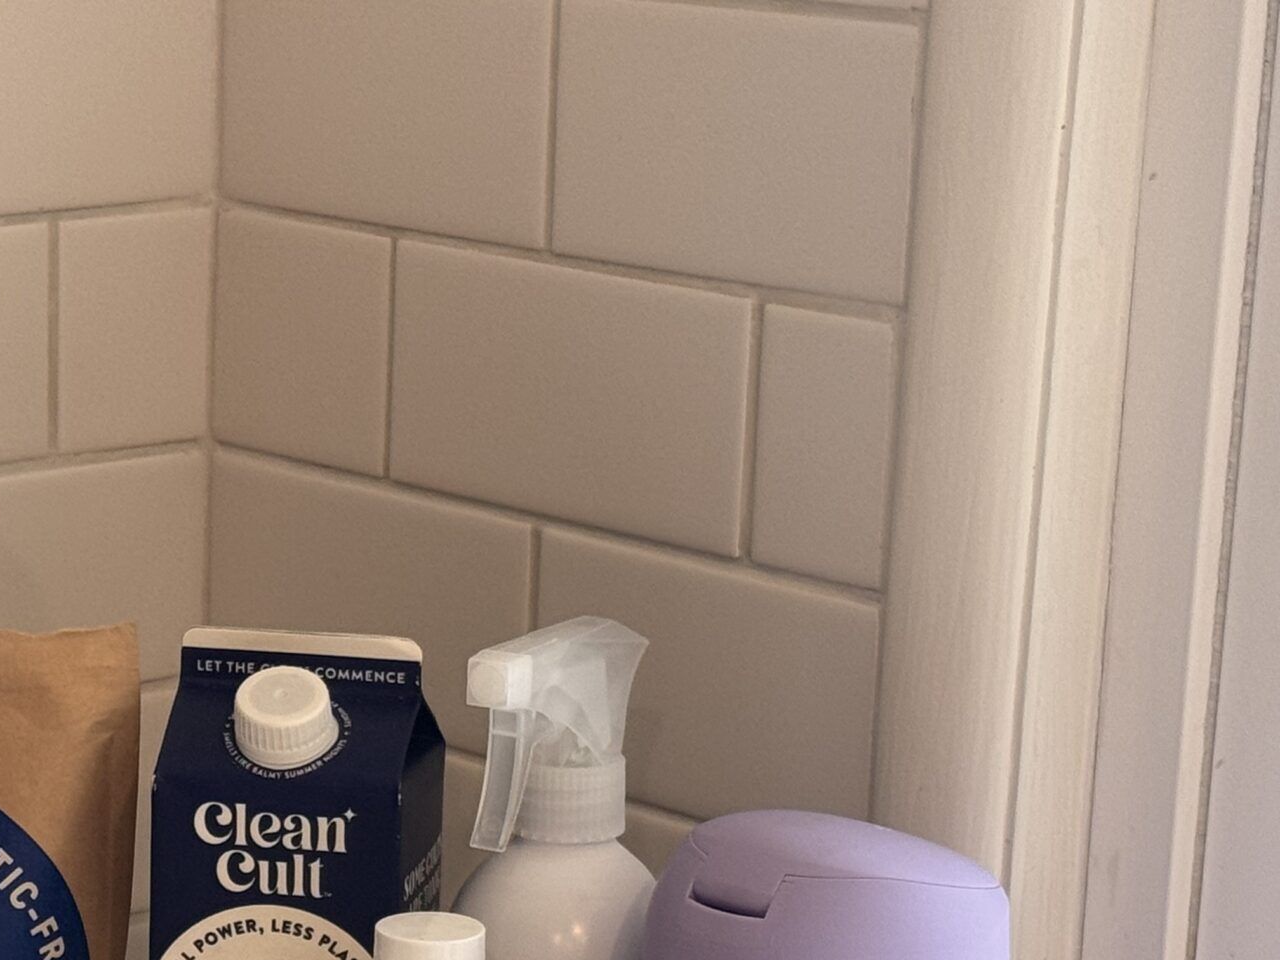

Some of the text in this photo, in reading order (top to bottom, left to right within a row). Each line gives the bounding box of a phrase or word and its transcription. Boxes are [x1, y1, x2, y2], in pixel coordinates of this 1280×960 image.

[197, 660, 222, 672] LET
[227, 661, 254, 674] THE
[315, 667, 406, 685] COMMENCE
[252, 766, 282, 780] BALMY
[284, 760, 325, 780] SUMMER
[194, 801, 347, 854] Clean
[216, 849, 324, 899] Cult
[193, 919, 264, 953] POWER,
[271, 919, 314, 941] LESS
